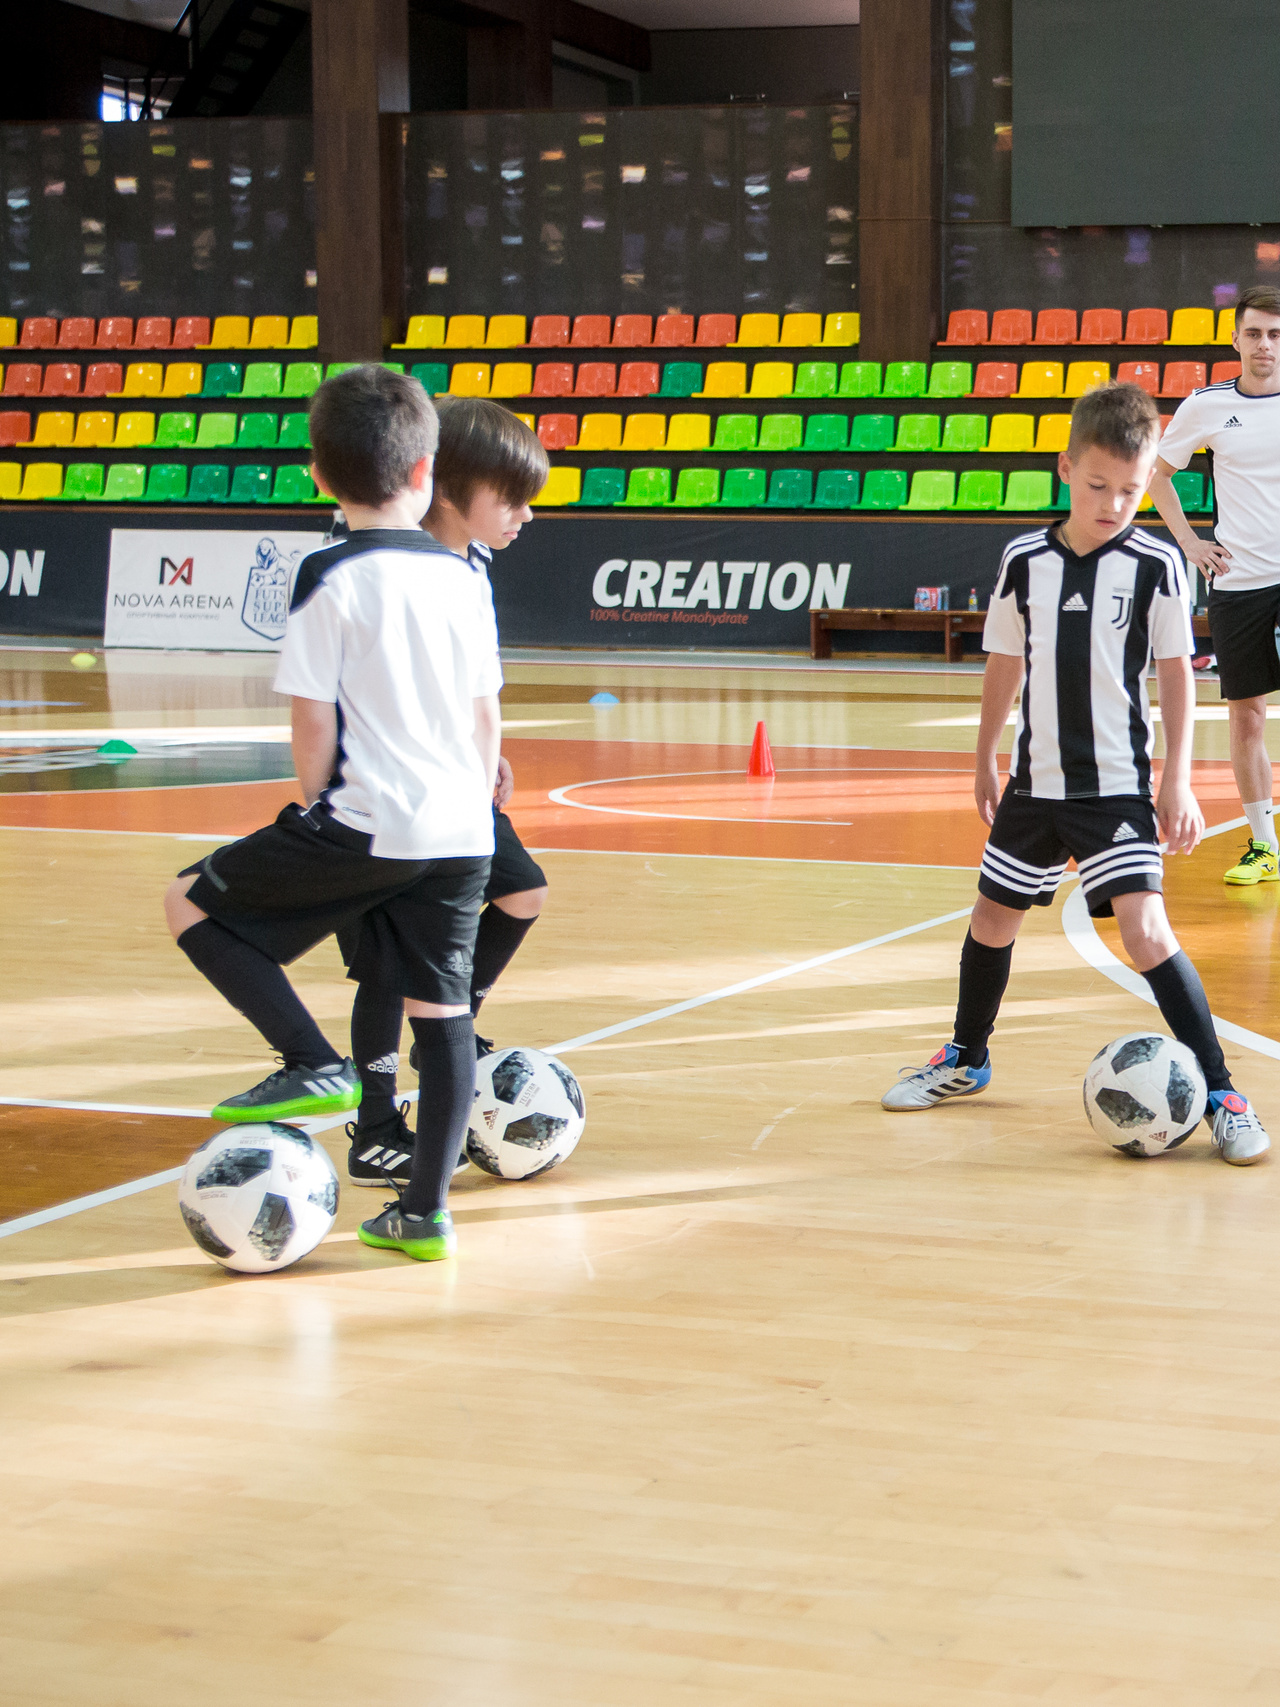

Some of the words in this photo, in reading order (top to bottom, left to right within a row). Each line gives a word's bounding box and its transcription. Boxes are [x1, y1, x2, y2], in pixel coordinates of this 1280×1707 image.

[0, 549, 46, 597] N
[254, 589, 286, 600] FUTS
[592, 558, 852, 611] CREATION
[113, 593, 165, 609] NOVA
[169, 594, 235, 610] ARENA
[590, 608, 620, 622] 100%
[622, 609, 669, 623] Creatine
[671, 610, 749, 627] Monohydrate
[487, 1107, 500, 1131] adidas
